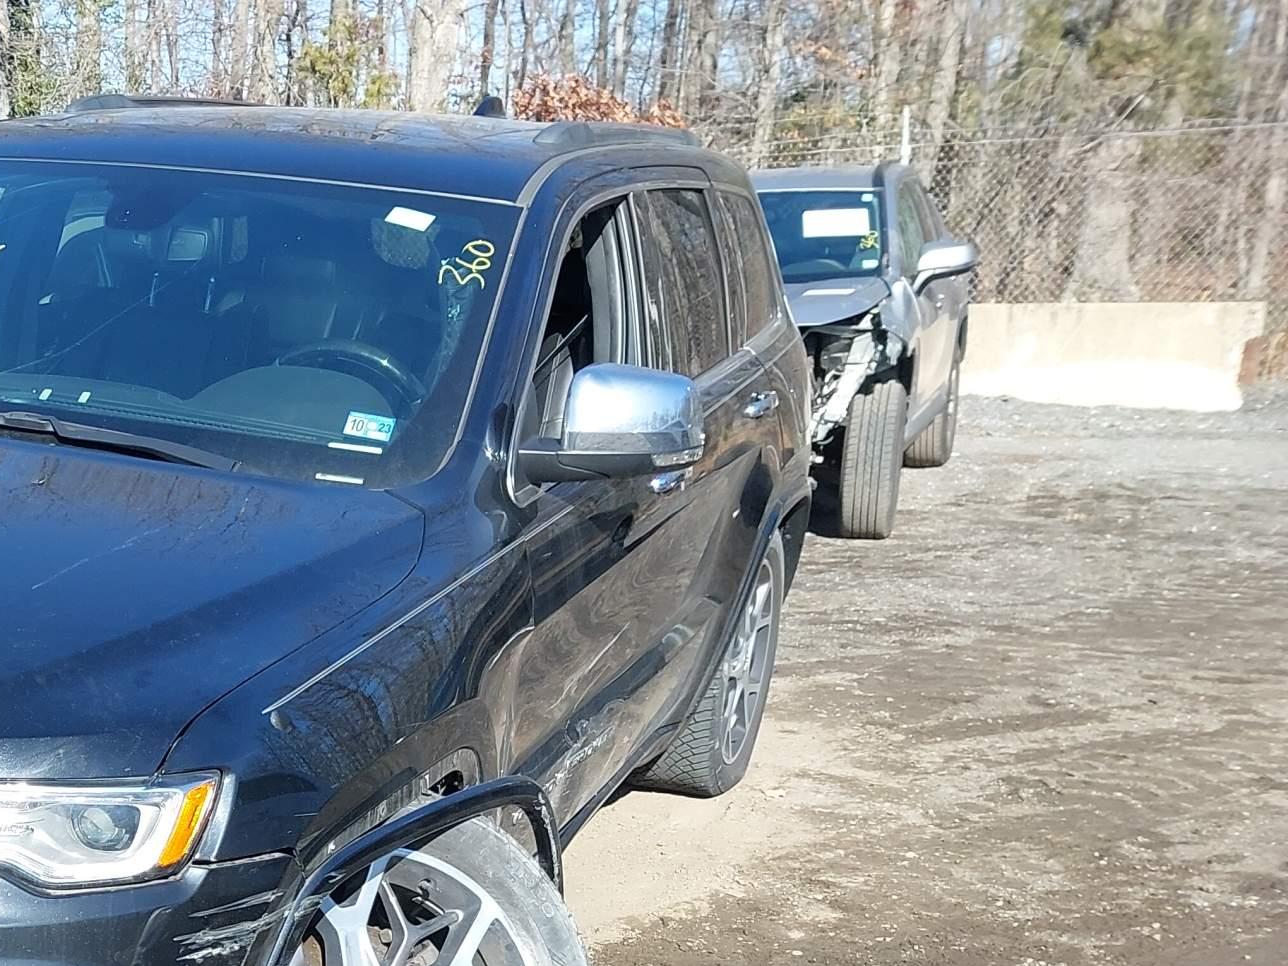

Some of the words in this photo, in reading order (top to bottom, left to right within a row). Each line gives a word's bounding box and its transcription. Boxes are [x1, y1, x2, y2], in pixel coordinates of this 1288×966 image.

[438, 239, 495, 290] 360
[350, 418, 365, 432] 10
[378, 422, 392, 434] 23
